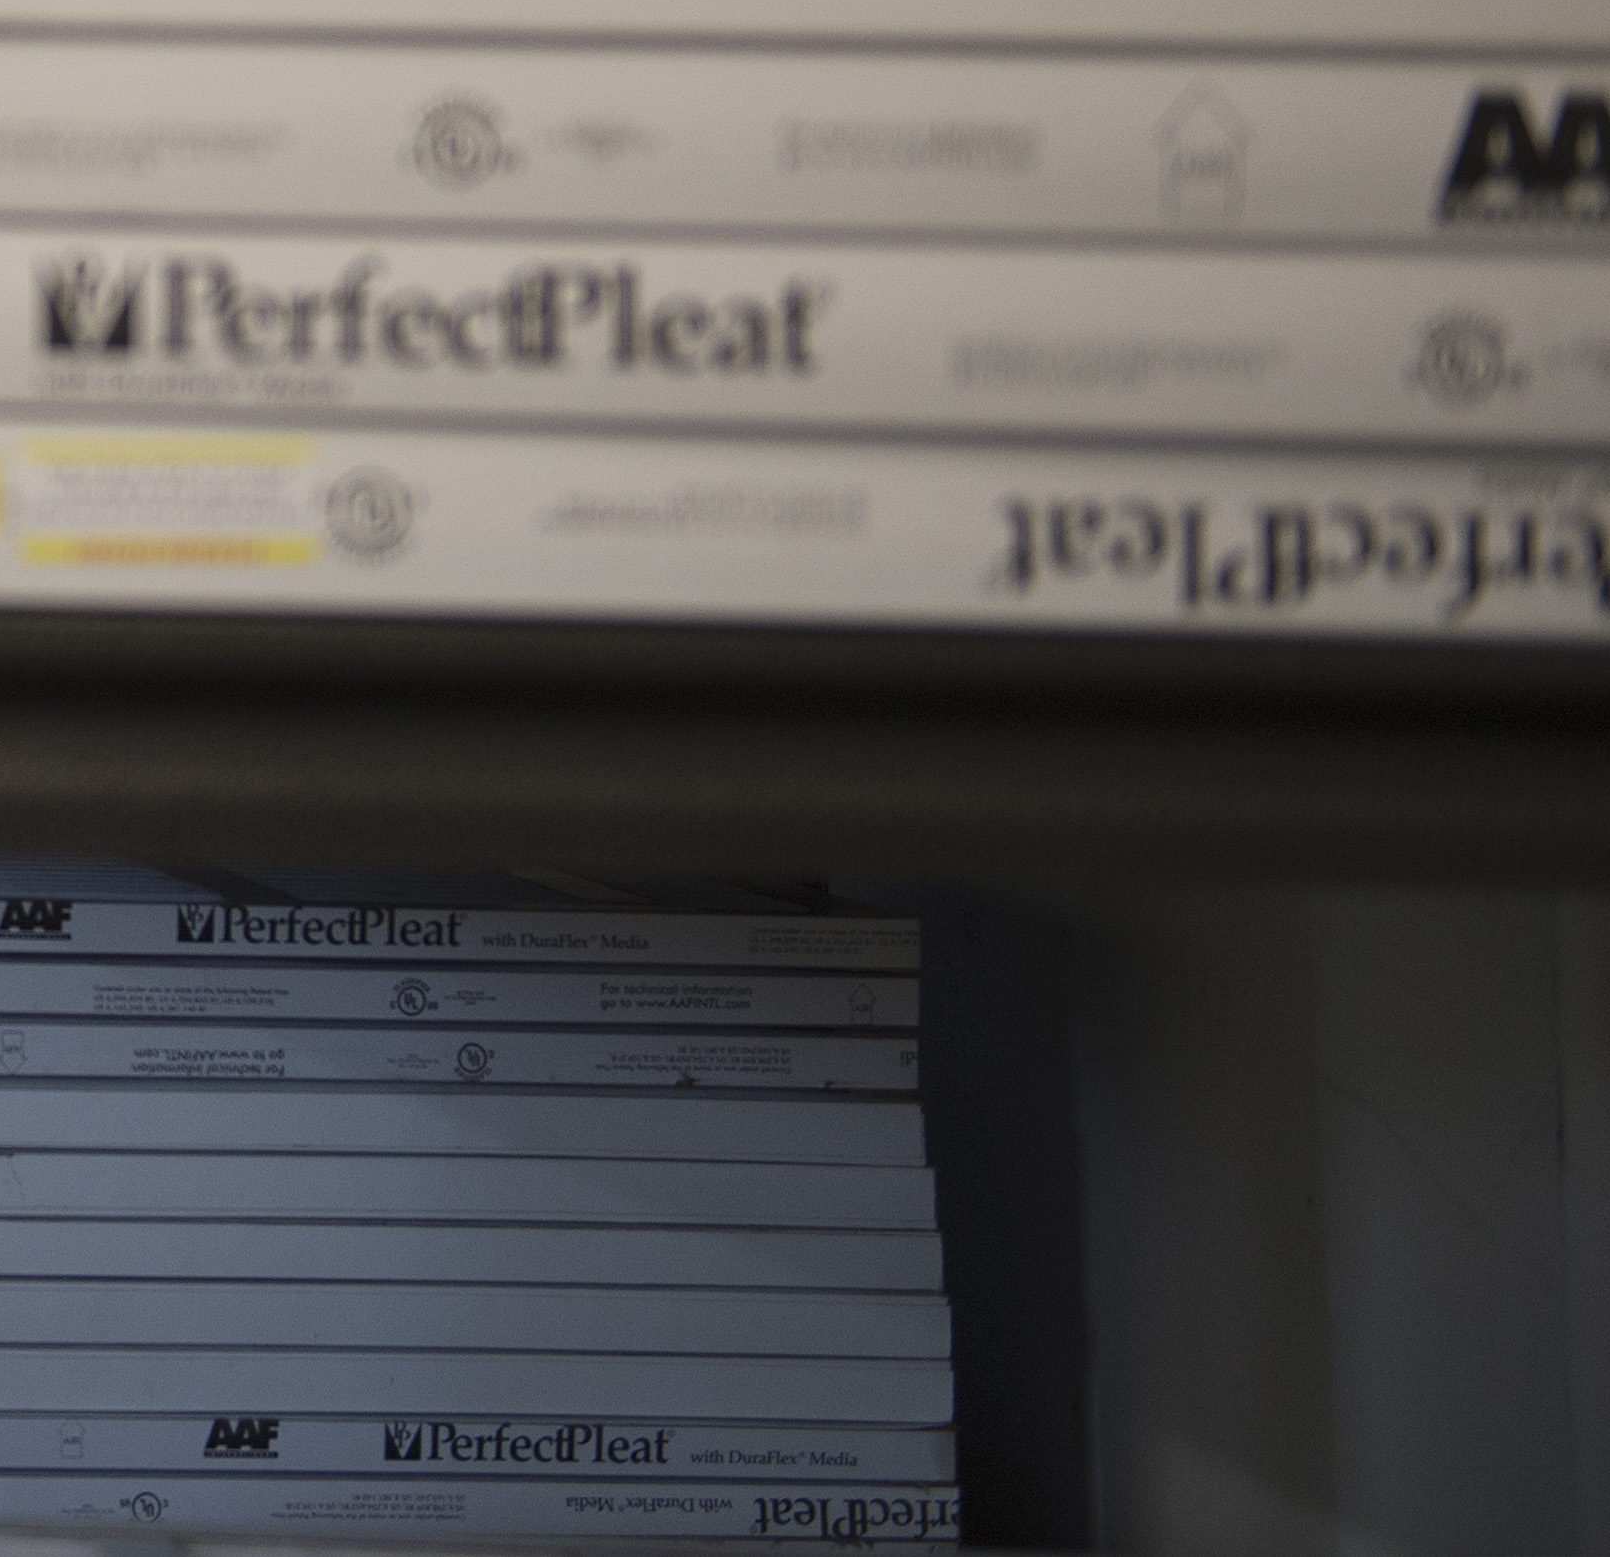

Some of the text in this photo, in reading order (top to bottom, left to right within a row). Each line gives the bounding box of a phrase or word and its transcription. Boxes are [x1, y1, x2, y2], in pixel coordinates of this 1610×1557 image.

[160, 256, 820, 374] PerfectPleat
[0, 901, 72, 932] AAF
[482, 932, 516, 948] with
[600, 934, 649, 950] Media
[600, 984, 753, 996] For technical information
[600, 999, 617, 1011] go
[621, 998, 633, 1009] to
[205, 1419, 279, 1449] AAF
[690, 1450, 725, 1465] with
[809, 1451, 859, 1467] Media
[566, 1496, 614, 1512] Media
[701, 1497, 734, 1513] with
